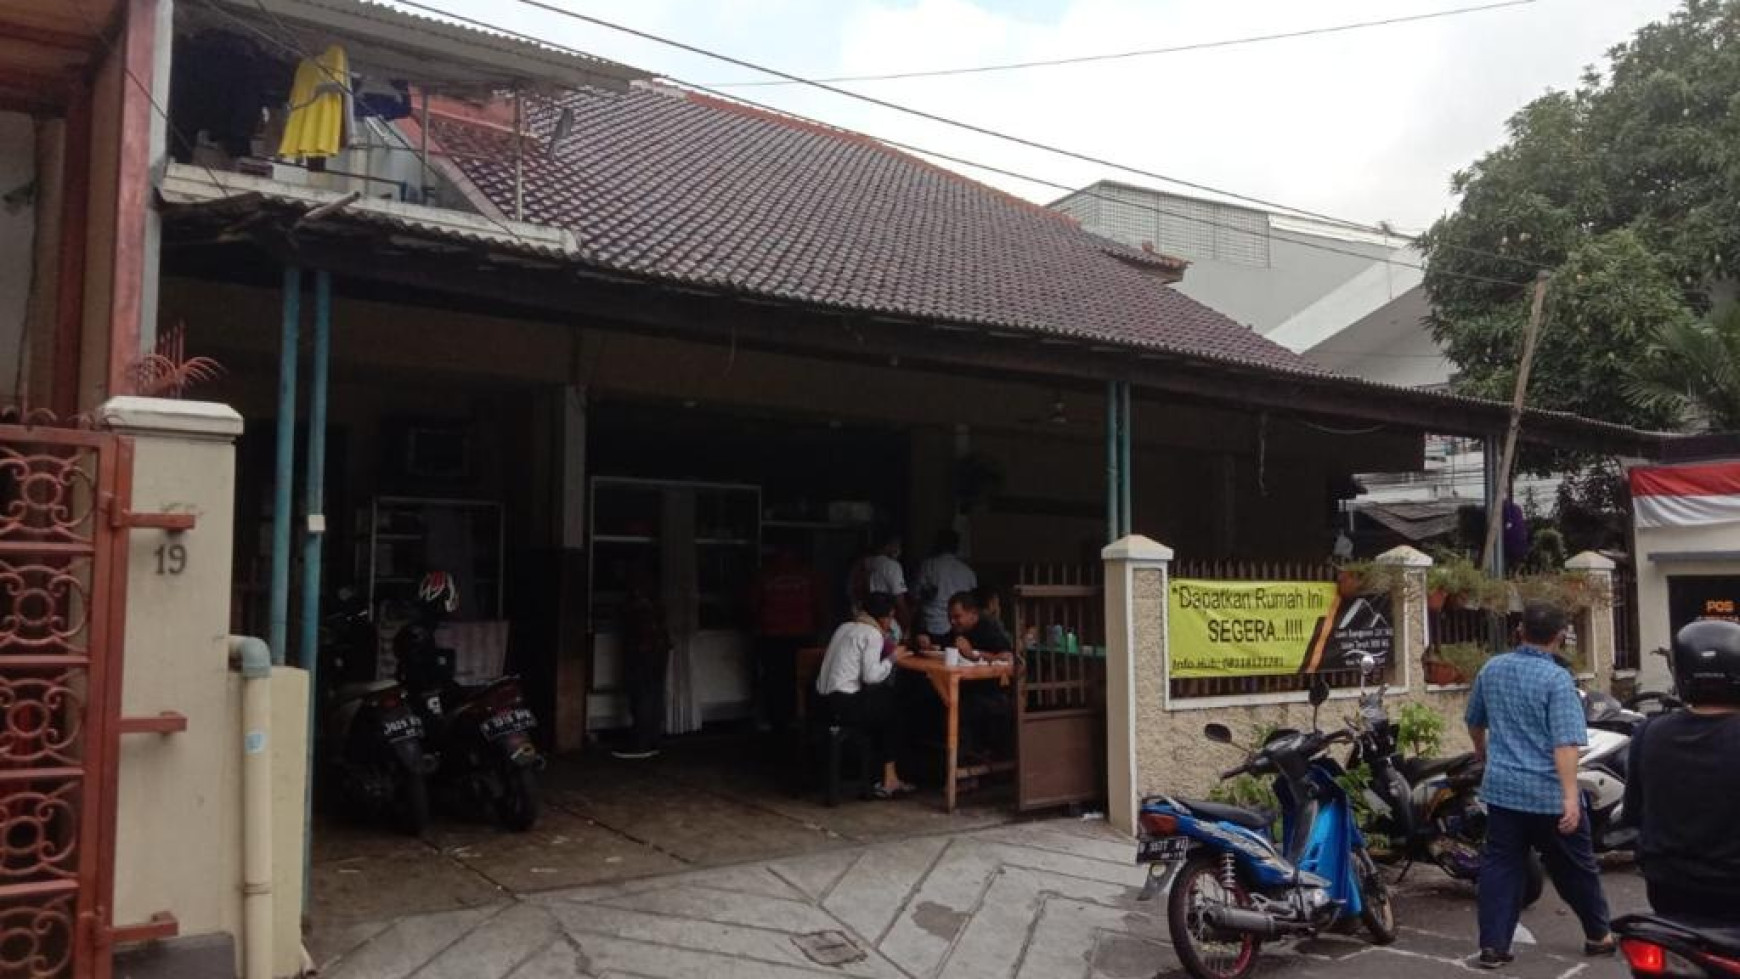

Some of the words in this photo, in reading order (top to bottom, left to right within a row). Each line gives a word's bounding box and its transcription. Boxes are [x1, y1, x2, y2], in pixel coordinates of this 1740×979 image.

[153, 544, 187, 576] 19
[1255, 588, 1304, 609] Rumah
[1308, 588, 1324, 609] Ini
